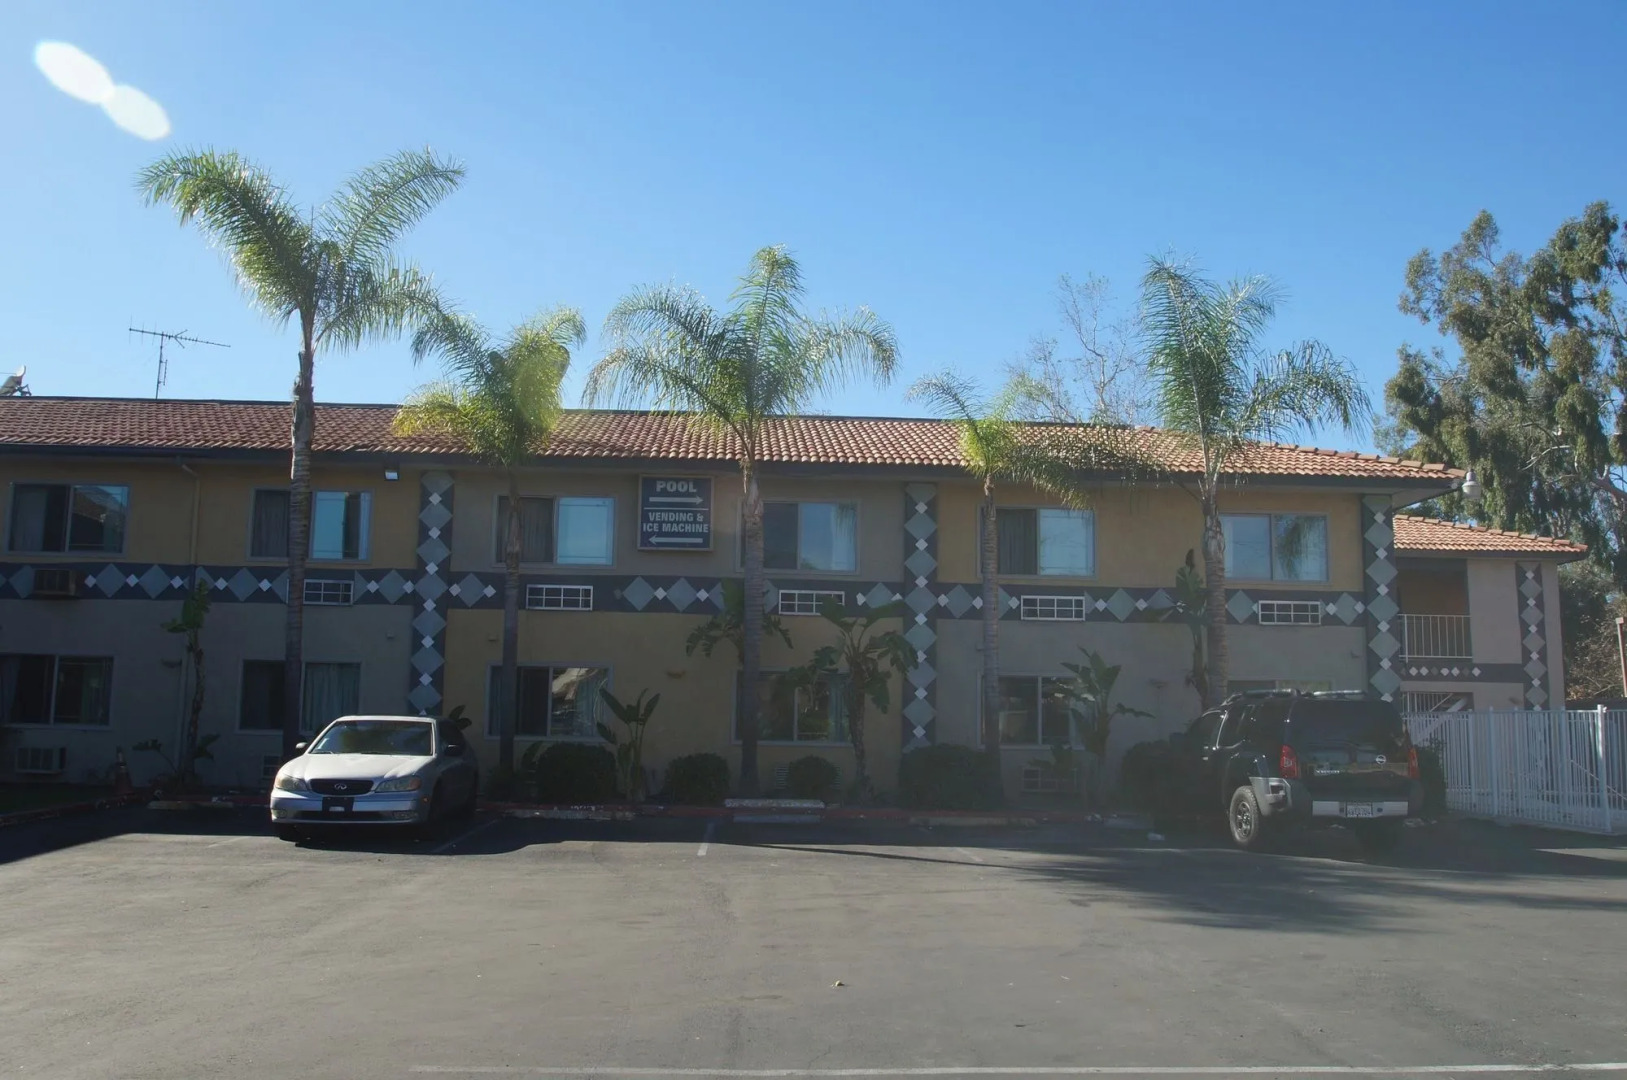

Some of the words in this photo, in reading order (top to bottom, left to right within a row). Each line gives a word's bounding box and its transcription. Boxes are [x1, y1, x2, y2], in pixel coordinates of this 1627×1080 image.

[656, 480, 697, 492] POOL
[648, 512, 694, 522] VENDING
[697, 513, 704, 522] &
[642, 523, 659, 532] ICE
[662, 523, 709, 533] MACHINE
